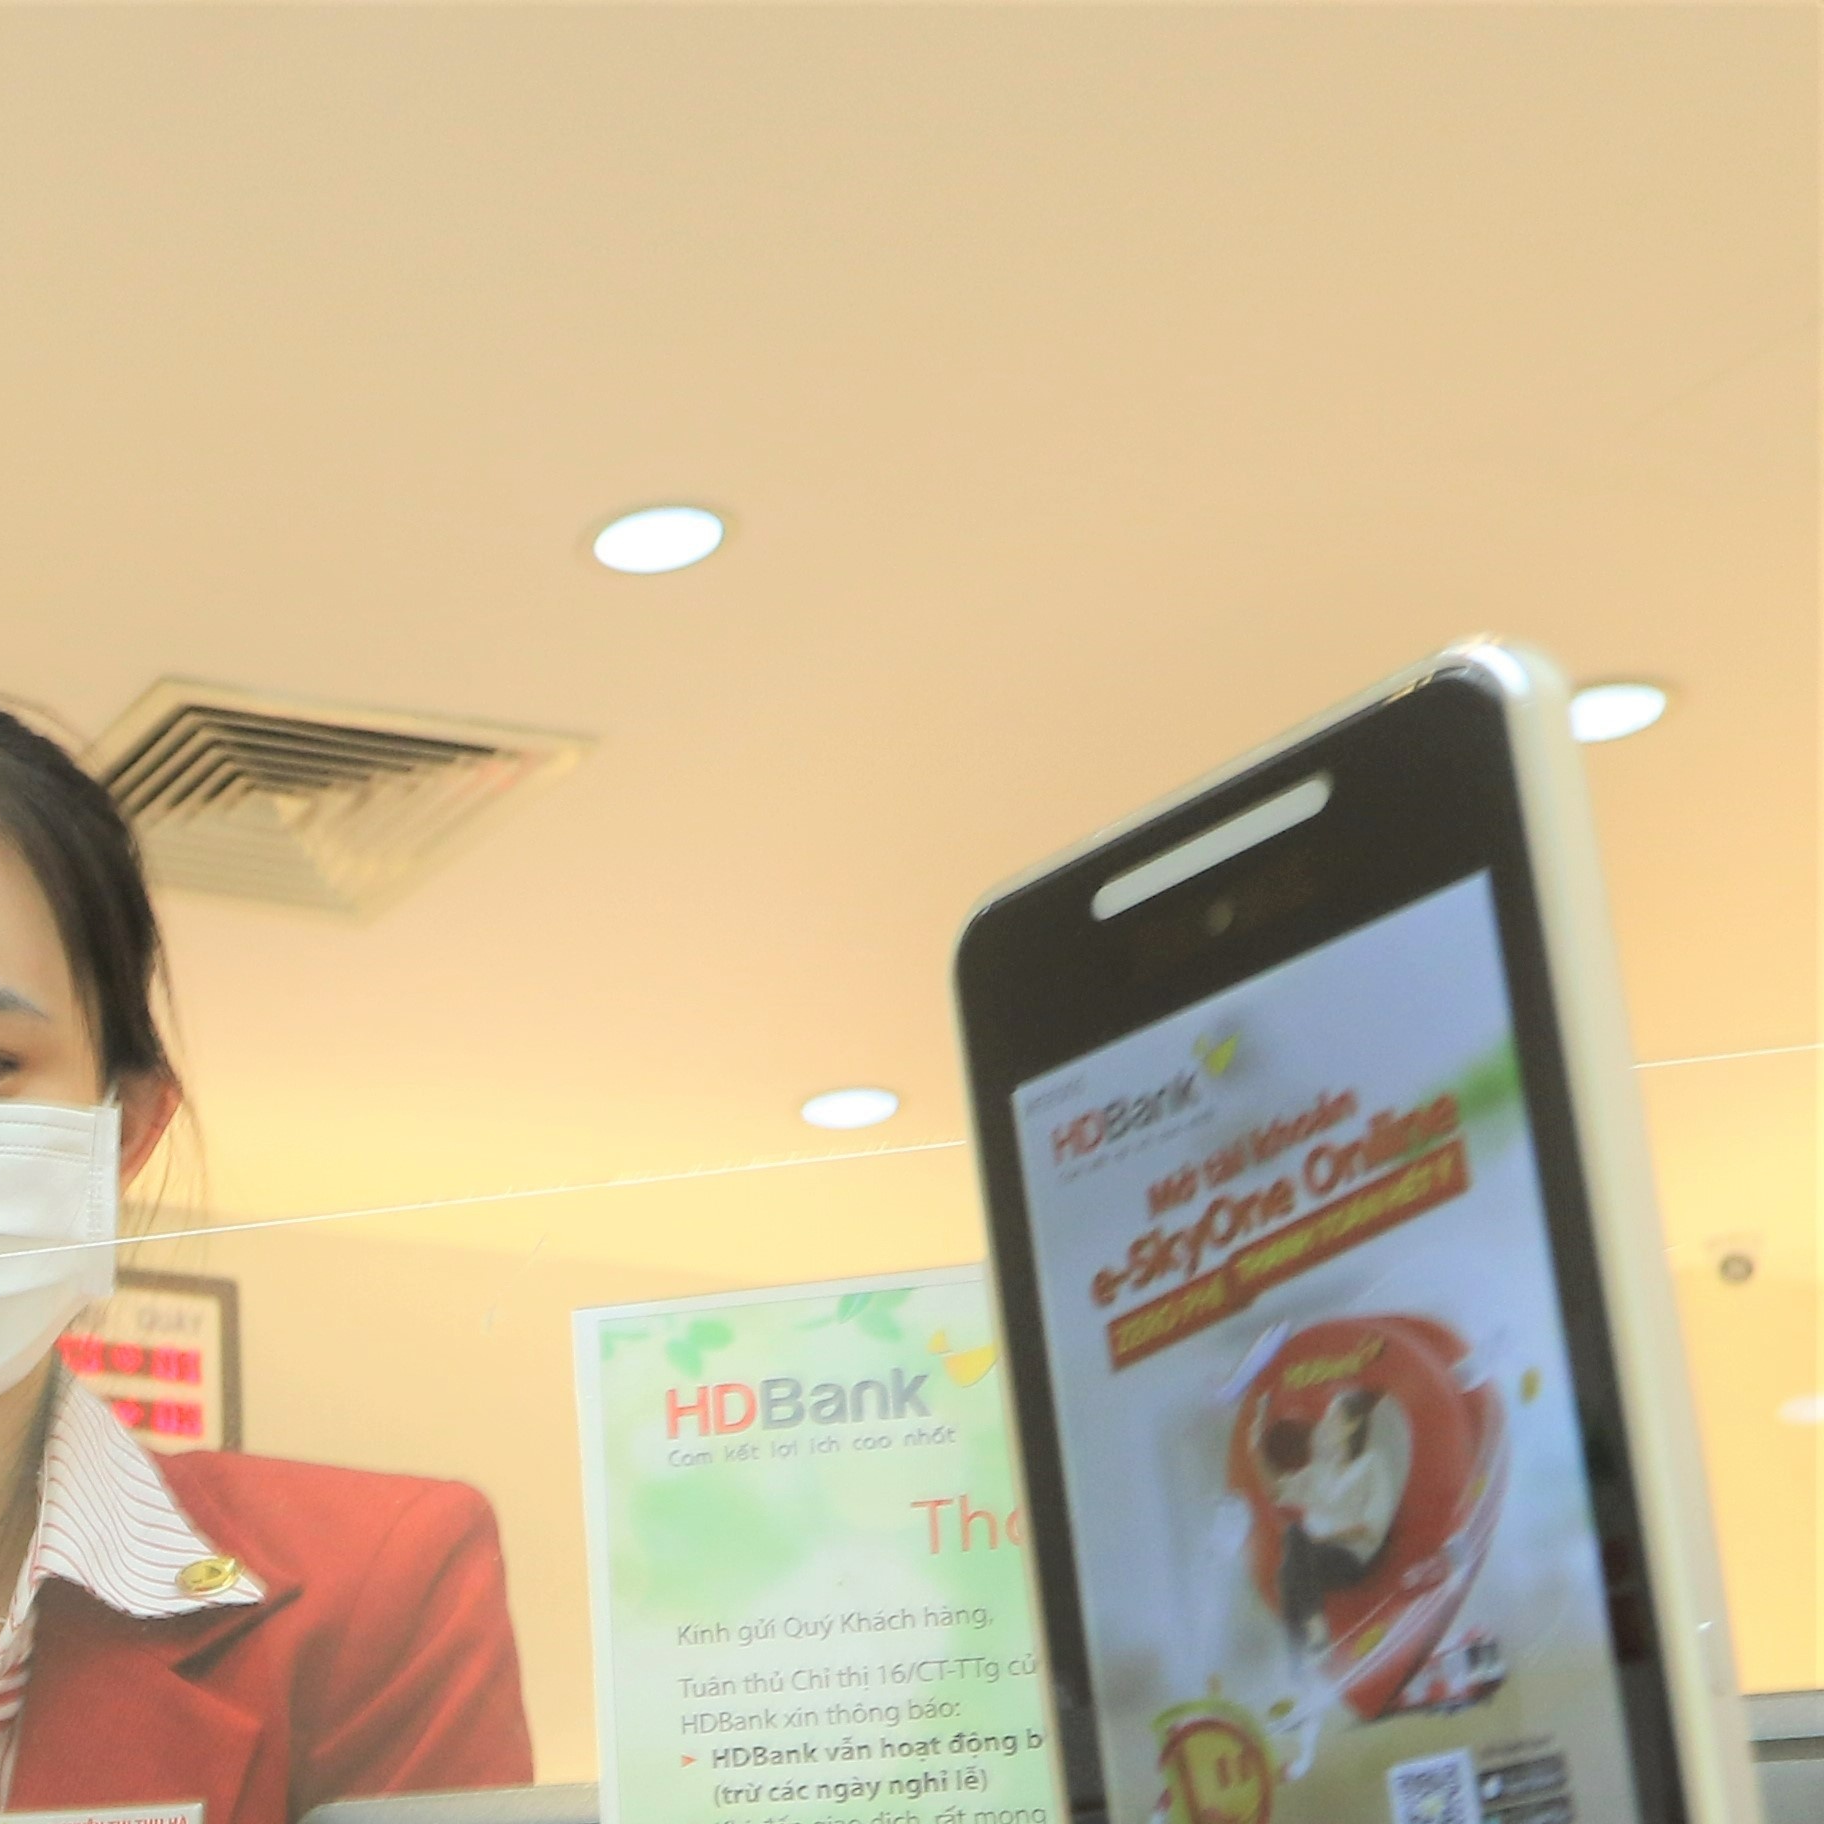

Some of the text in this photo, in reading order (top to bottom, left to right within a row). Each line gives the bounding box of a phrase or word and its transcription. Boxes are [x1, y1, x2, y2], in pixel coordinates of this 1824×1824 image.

[665, 1367, 932, 1440] HDBank
[668, 1449, 712, 1468] Cam
[724, 1440, 759, 1463] kết
[852, 1434, 891, 1451] cao
[905, 1426, 956, 1447] nhất
[677, 1605, 993, 1646] Kính gửi Quý Khách hàng,
[678, 1653, 1037, 1698] Tuân thủ Chỉ thị 16/CT-TTg củ
[682, 1709, 776, 1734] HDBank
[784, 1706, 818, 1728] xin
[826, 1699, 900, 1727] thông
[711, 1740, 817, 1769] HDBank
[825, 1734, 872, 1761] vẫn
[880, 1736, 941, 1763] hoạt
[950, 1729, 1018, 1756] động
[714, 1765, 988, 1808] (trừ các ngày nghỉ lễ)
